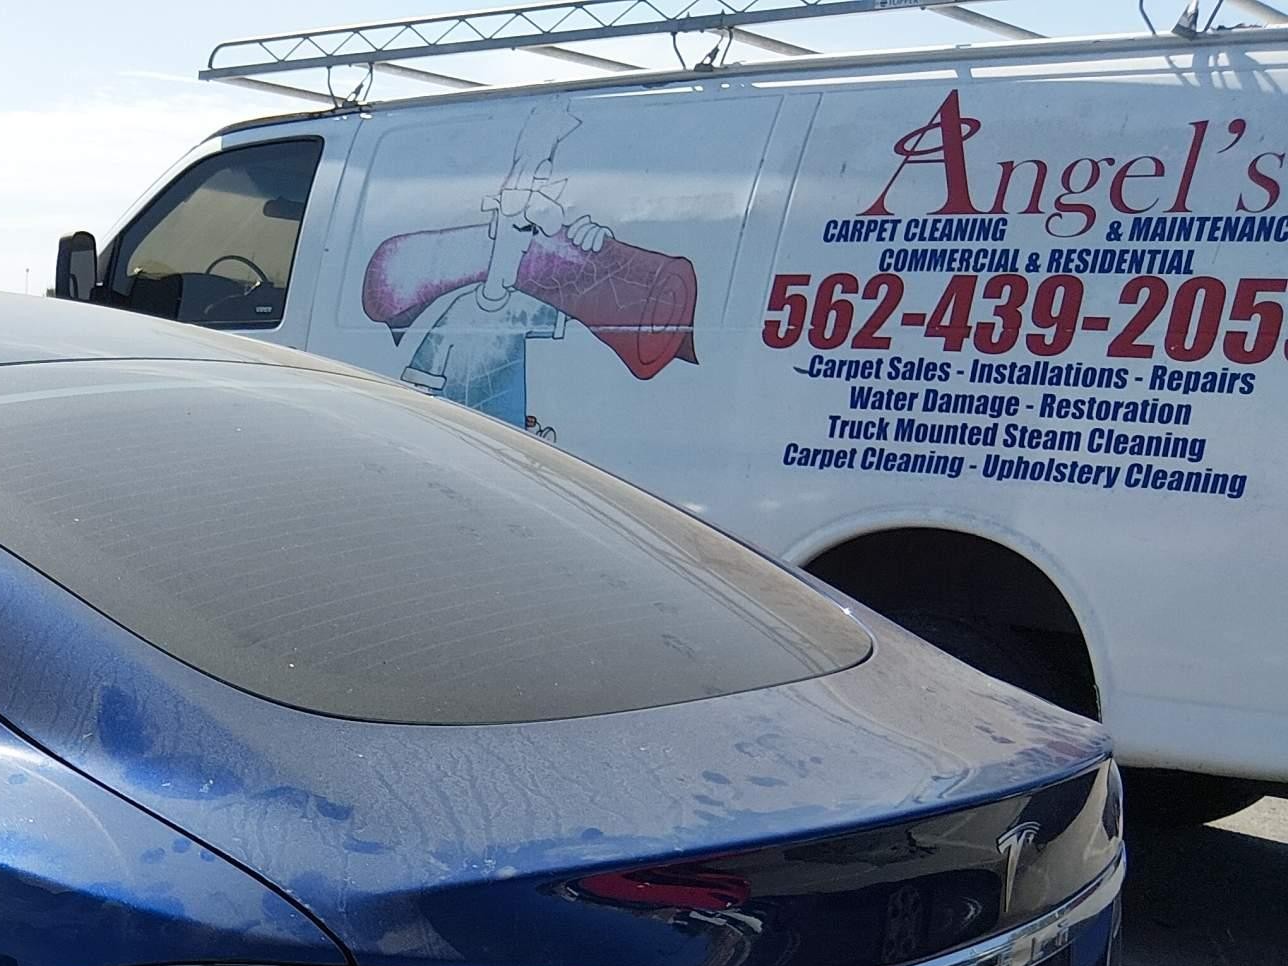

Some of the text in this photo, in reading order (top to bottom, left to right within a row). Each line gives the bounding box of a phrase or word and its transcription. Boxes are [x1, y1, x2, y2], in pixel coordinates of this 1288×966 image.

[855, 89, 1286, 237] Angel's
[822, 218, 903, 244] CARPET
[903, 216, 1009, 243] CLEANING
[1105, 219, 1124, 242] &
[878, 247, 1195, 275] COMMERCIAL & RESIDENTIAL
[761, 272, 1288, 365] 562-439-205
[808, 354, 884, 382] Carpet
[886, 356, 952, 382] Sales
[969, 358, 1129, 390] Installations
[1148, 364, 1256, 395] Repairs
[849, 385, 920, 412] Water
[921, 388, 1020, 419] Damage
[1039, 393, 1192, 426] Restoration
[828, 415, 1207, 463] Truck Mounted Steam Cleaning
[782, 442, 857, 470] Carpet
[860, 446, 965, 479] Cleaning
[982, 453, 1121, 489] Upholstery
[1124, 462, 1248, 499] Cleaning
